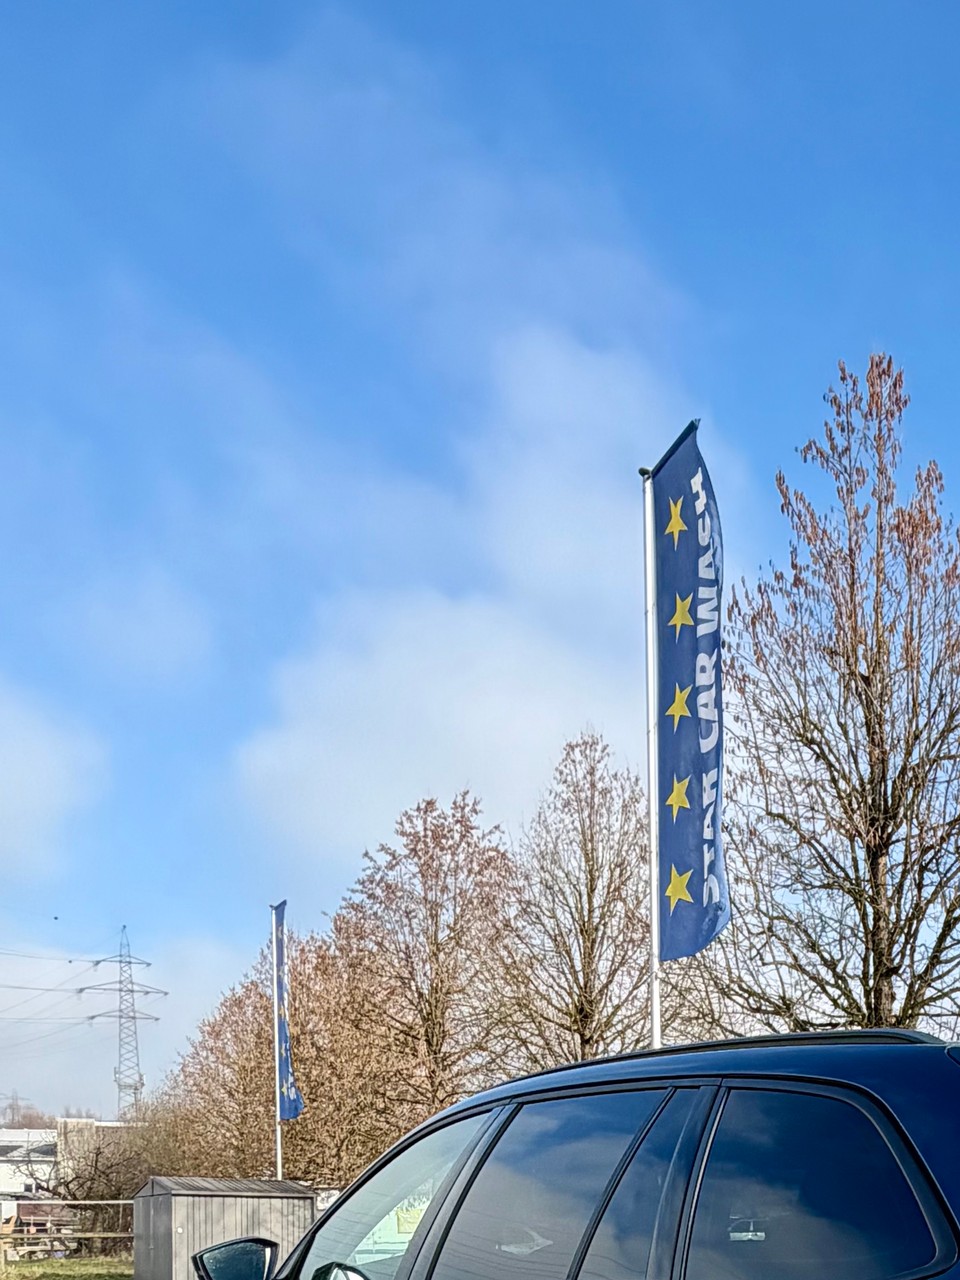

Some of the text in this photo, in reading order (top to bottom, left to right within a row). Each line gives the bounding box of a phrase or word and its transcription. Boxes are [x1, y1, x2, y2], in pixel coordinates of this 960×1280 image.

[690, 467, 720, 907] STAR CAR WASH
